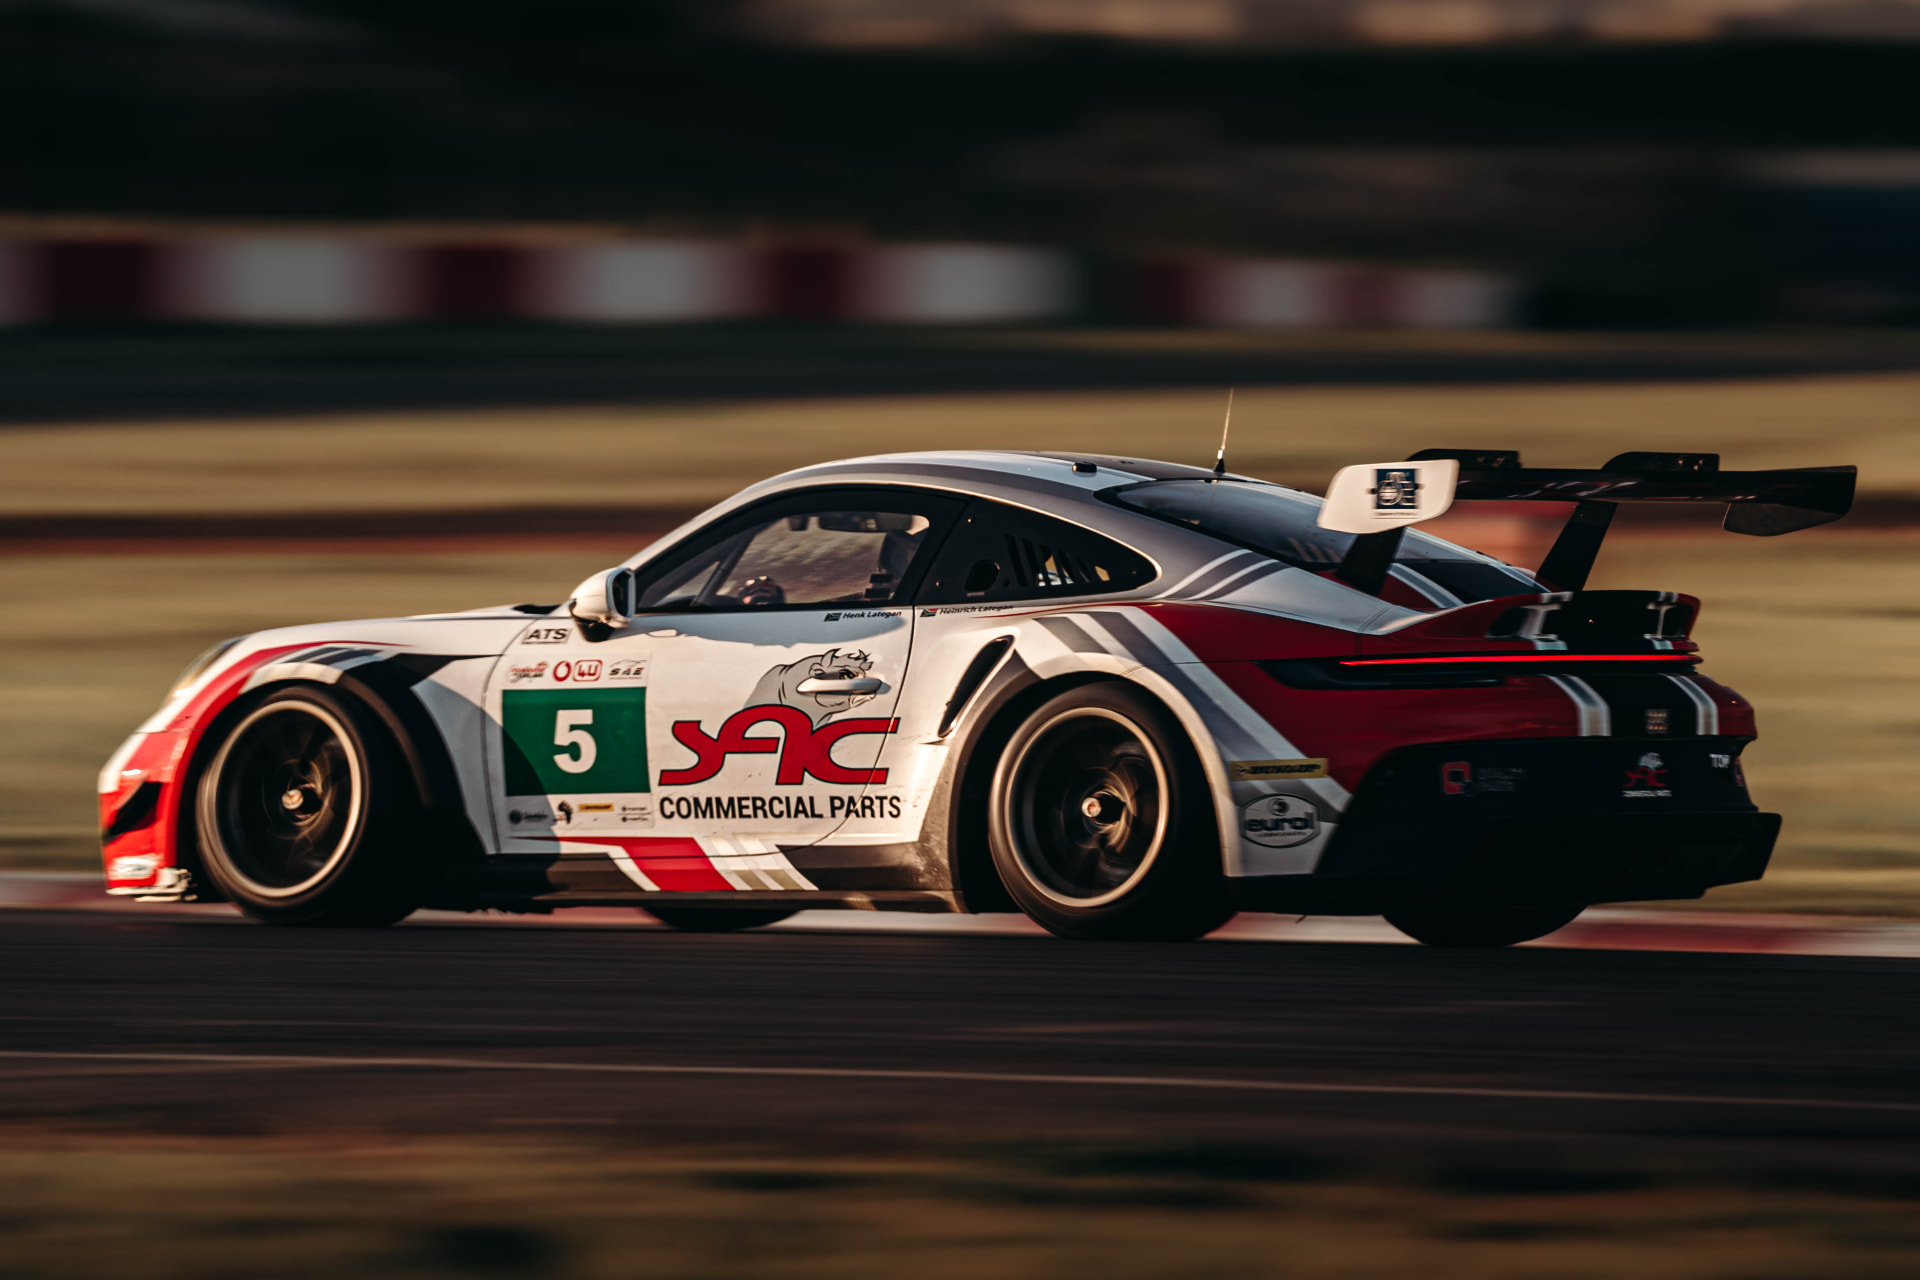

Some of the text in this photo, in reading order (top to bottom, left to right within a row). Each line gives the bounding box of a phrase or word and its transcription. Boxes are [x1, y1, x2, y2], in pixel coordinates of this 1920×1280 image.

[842, 611, 902, 619] Henk Lategan
[527, 628, 568, 640] ATS
[553, 709, 597, 774] 5
[658, 703, 901, 786] SAC
[659, 795, 902, 820] COMMERCIAL PARTS
